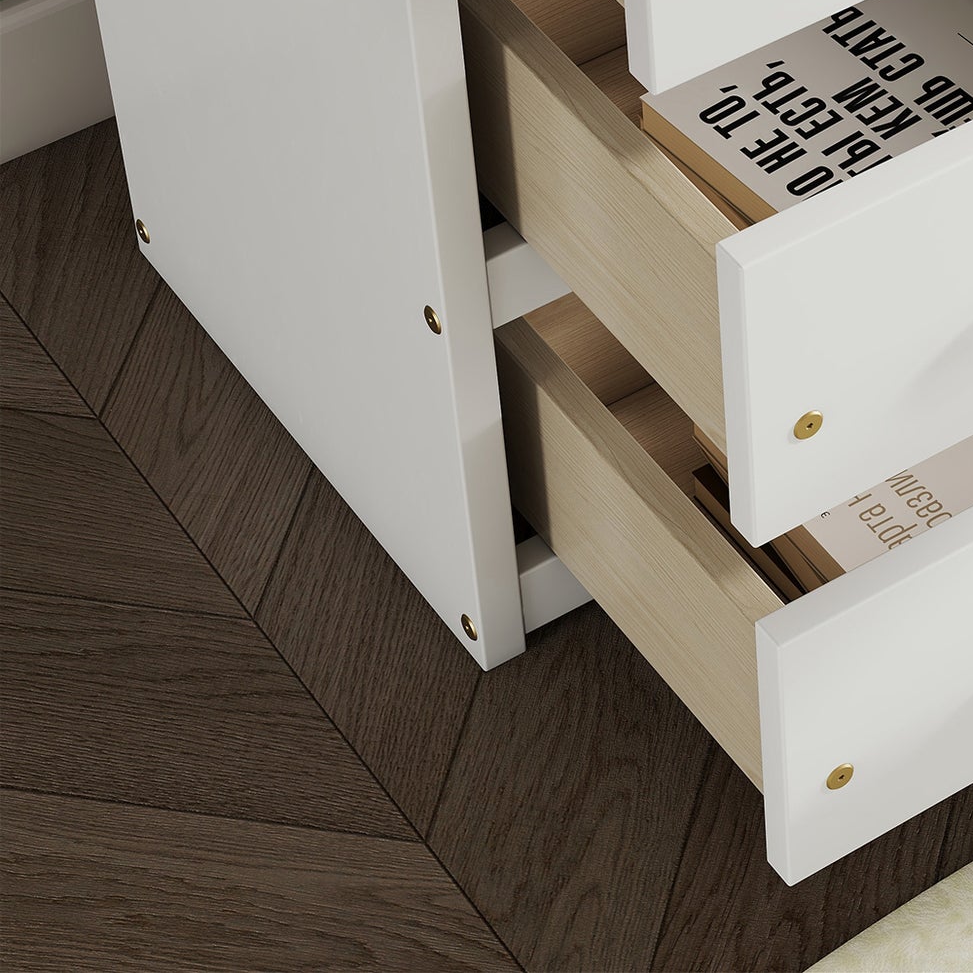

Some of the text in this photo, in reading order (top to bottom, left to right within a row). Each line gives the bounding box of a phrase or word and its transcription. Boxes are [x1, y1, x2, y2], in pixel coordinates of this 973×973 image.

[822, 6, 925, 82] СТАТЬ
[698, 84, 761, 140] ТО,
[752, 60, 844, 140] ЕСТЬ,
[831, 76, 922, 140] КЕМ
[739, 128, 807, 174] НЕ
